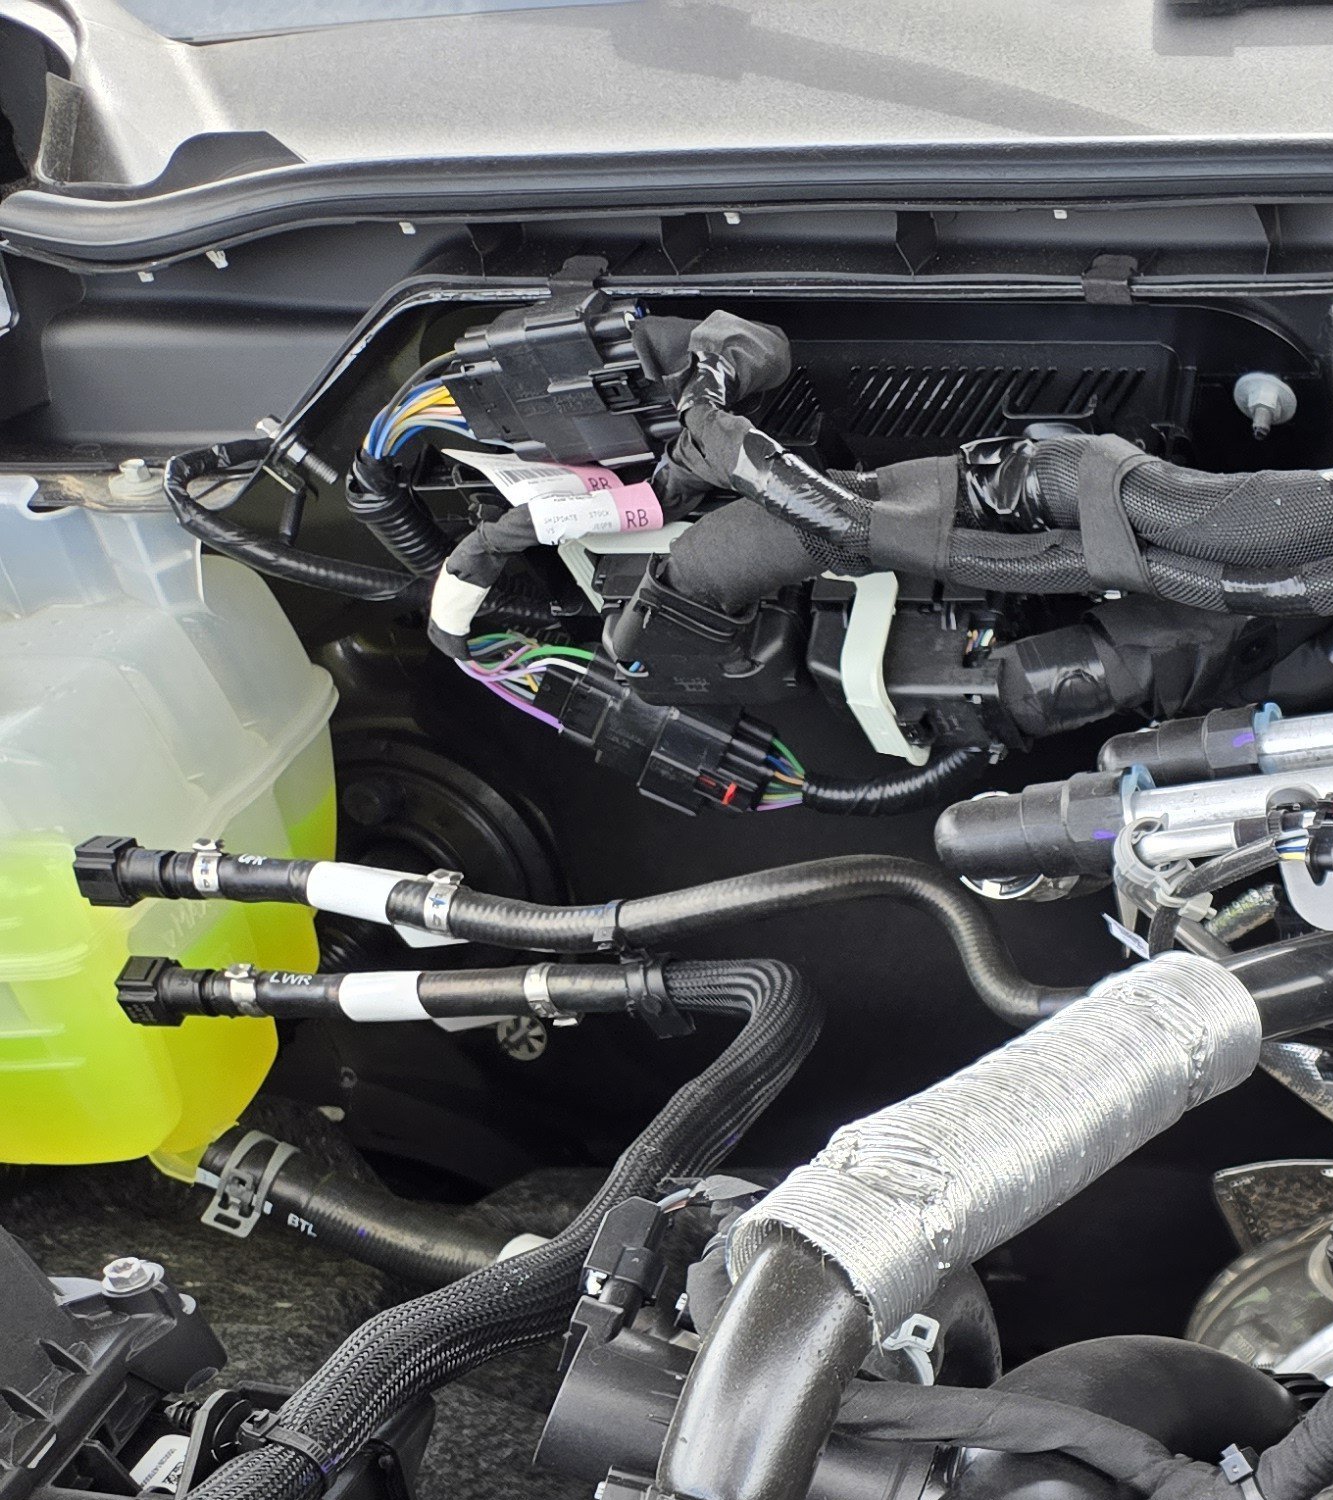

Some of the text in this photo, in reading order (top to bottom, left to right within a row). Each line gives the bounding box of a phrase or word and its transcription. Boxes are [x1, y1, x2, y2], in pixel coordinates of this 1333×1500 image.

[625, 509, 650, 529] RB
[269, 971, 313, 986] LWR
[287, 1213, 317, 1238] BTL
